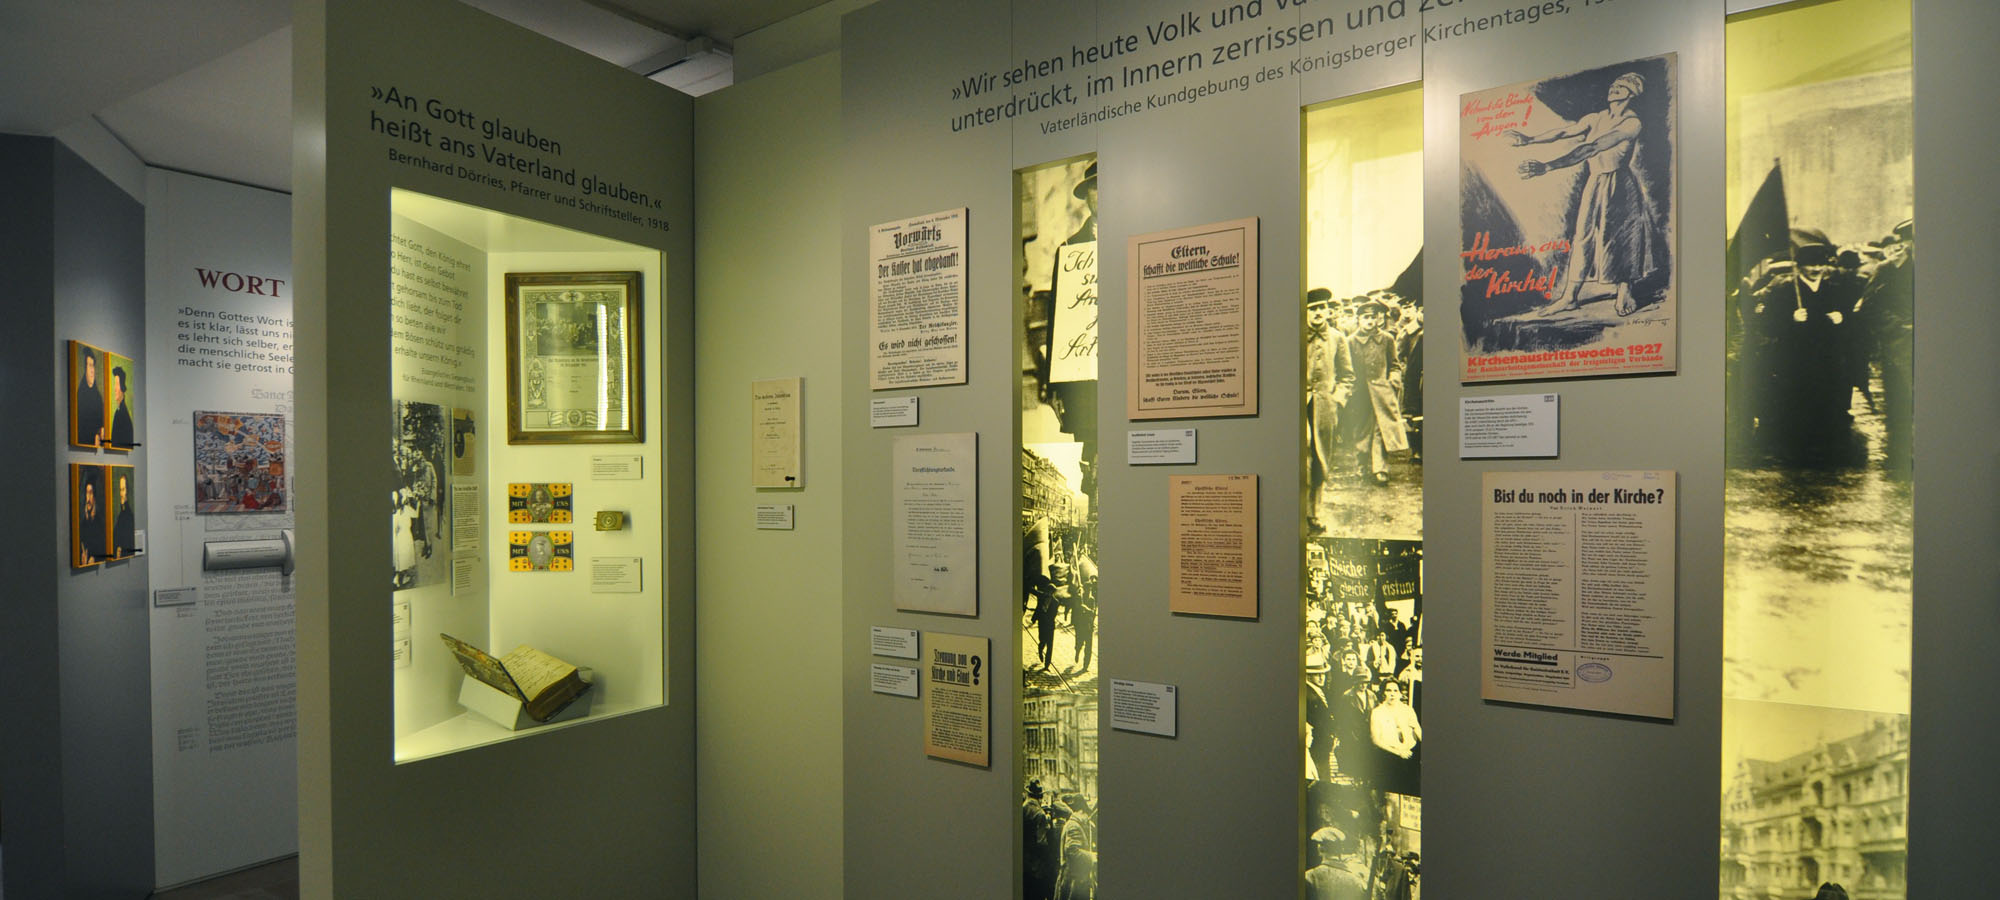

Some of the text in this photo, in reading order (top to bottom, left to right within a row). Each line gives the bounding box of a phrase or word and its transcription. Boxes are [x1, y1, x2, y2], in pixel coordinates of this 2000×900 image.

[1003, 56, 1064, 88] sehen
[1072, 35, 1138, 68] heute
[1147, 12, 1202, 45] Volk
[1211, 0, 1263, 28] und
[951, 0, 1405, 132] unterdrückt, im Innern zerrissen und
[1041, 0, 1571, 135] Vaterländische Kundgebung des Königsberger Kirchentages,
[426, 99, 476, 130] Gott
[481, 119, 561, 156] glauben
[370, 112, 432, 146] heißt
[440, 136, 476, 158] ans
[482, 144, 575, 186] Vaterland
[389, 148, 669, 231] Bernhard Dörries, Pfarrer und Schriftsteller, 1918
[894, 225, 941, 249] Vorwärts
[1461, 232, 1570, 262] Heraus aus
[1064, 251, 1094, 272] Ich
[1171, 245, 1210, 259] Eltern,
[1166, 263, 1175, 273] die
[1465, 265, 1494, 280] der
[195, 268, 285, 297] WORT
[1486, 266, 1557, 300] Kirche!
[178, 320, 190, 328] es
[193, 320, 205, 329] ist
[210, 321, 232, 333] klar,
[236, 326, 258, 336] lässt
[219, 311, 254, 323] Gottes
[257, 316, 283, 326] Wort
[178, 332, 190, 341] es
[193, 332, 219, 344] lehrt
[223, 336, 243, 346] sich
[246, 339, 279, 351] selber,
[891, 340, 905, 349] wird
[178, 345, 195, 354] die
[200, 347, 265, 360] menschliche
[1468, 343, 1662, 366] Kirchenaustrittswoche 1927
[178, 358, 213, 368] macht
[217, 360, 231, 369] sie
[235, 363, 272, 372] getrost
[1494, 489, 1664, 504] Bist du noch in der Kirche?
[1494, 649, 1558, 660] Werde Mitglied
